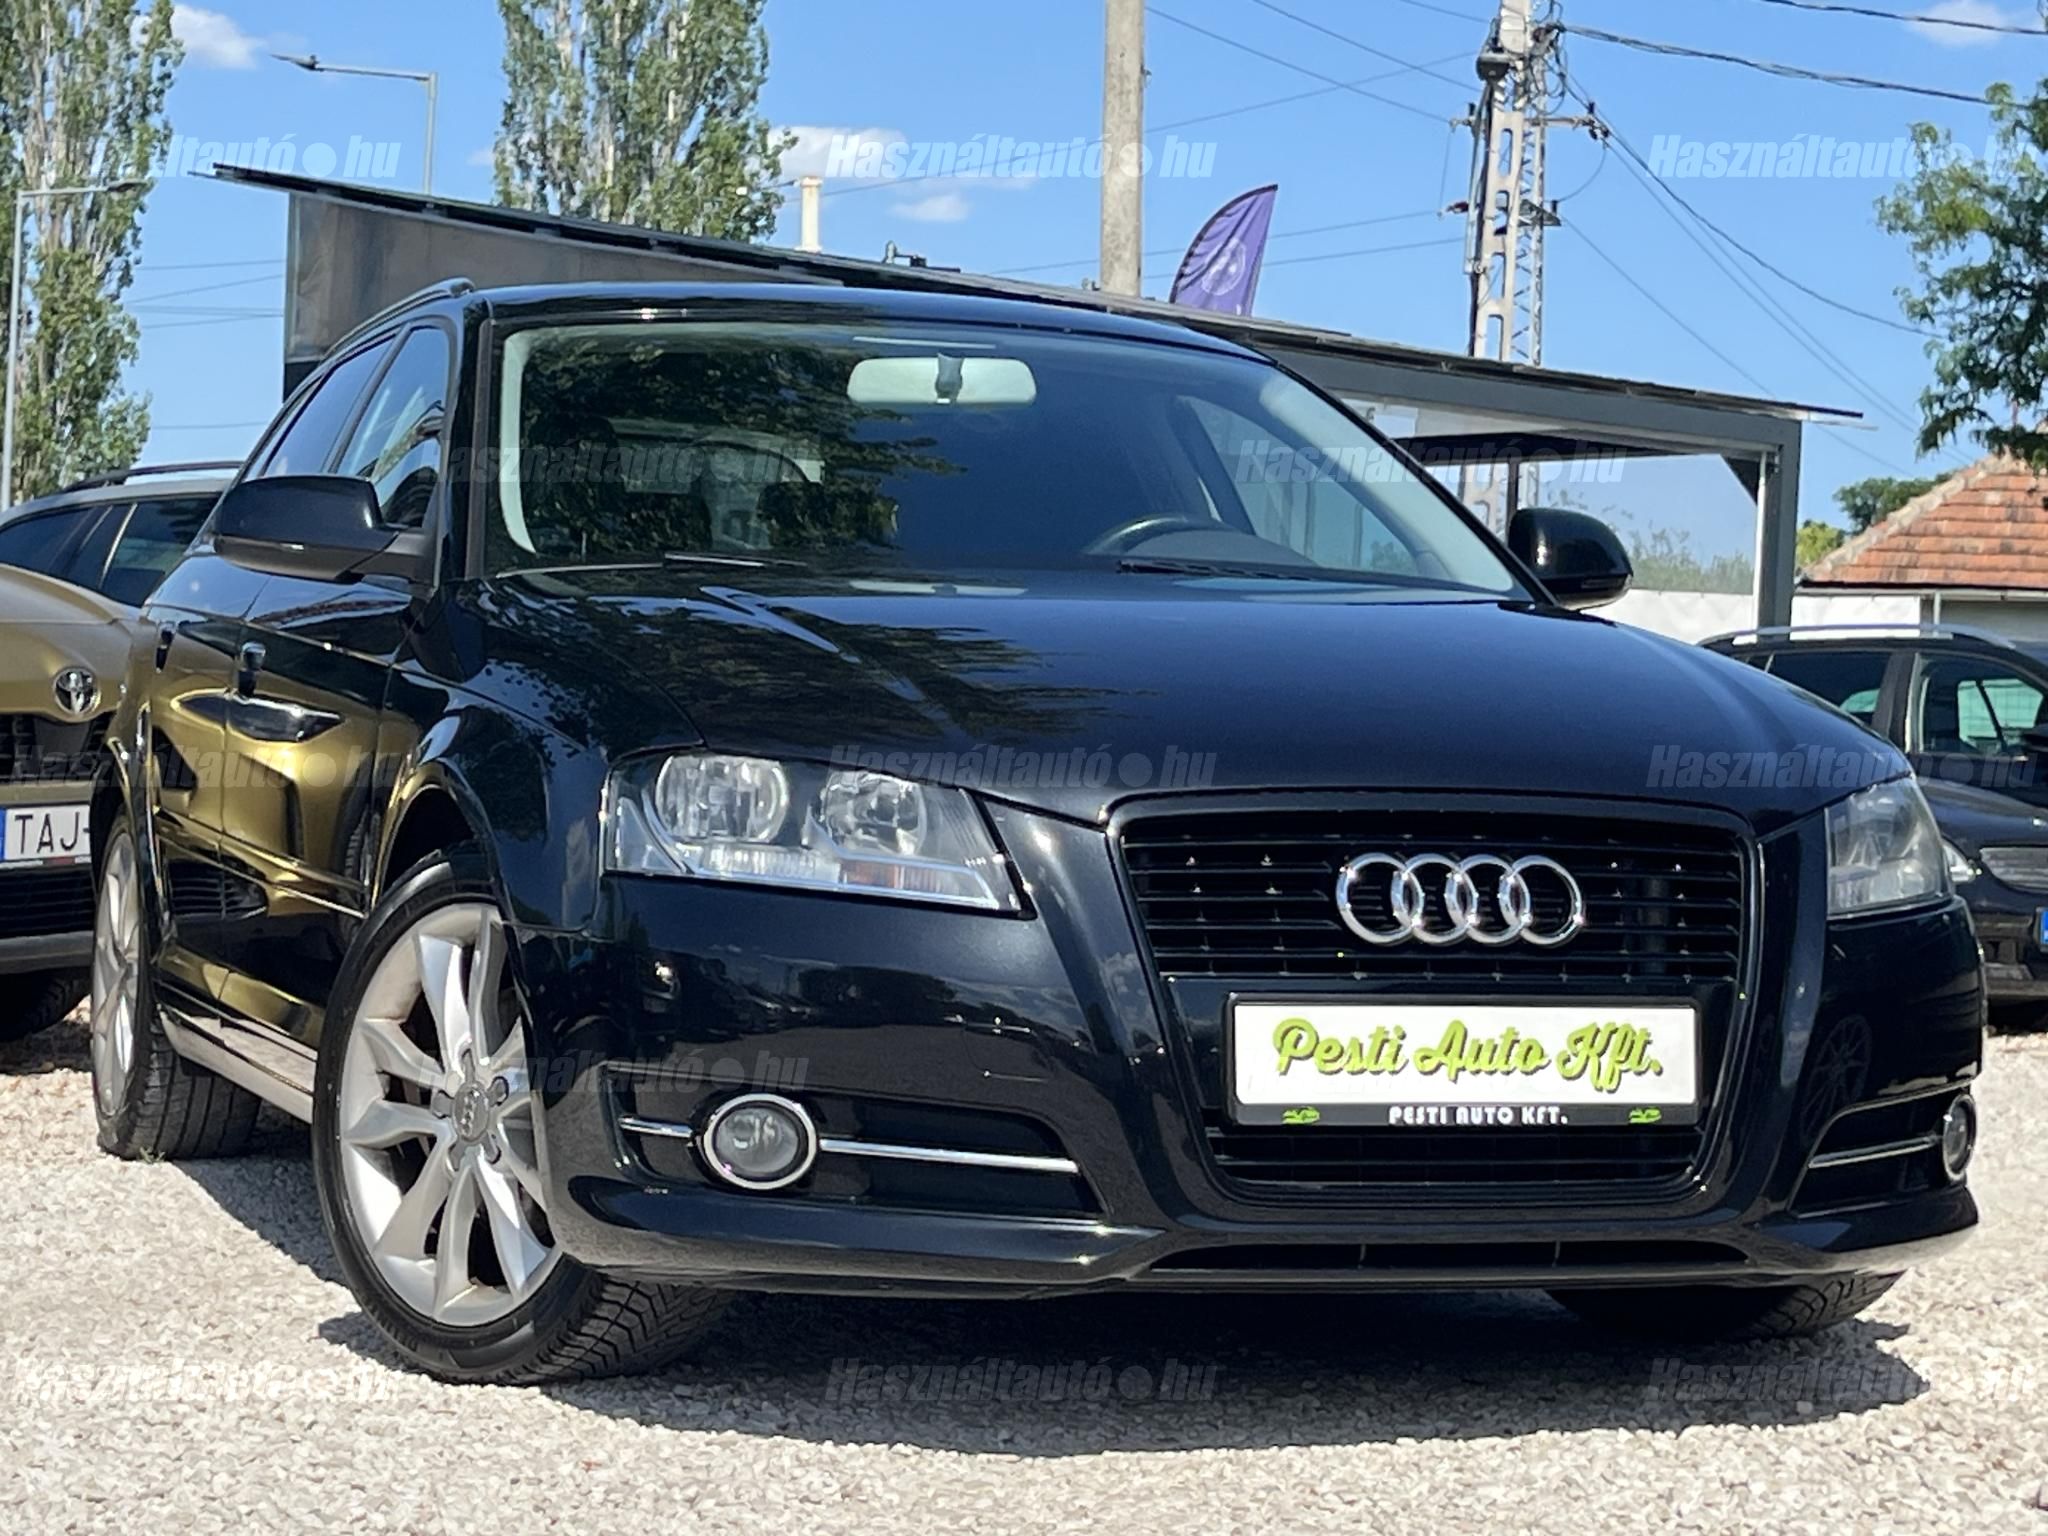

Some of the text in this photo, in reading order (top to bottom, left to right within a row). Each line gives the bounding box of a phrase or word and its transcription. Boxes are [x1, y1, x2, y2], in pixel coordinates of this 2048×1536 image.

[1273, 1018, 1406, 1077] Pesti
[1413, 1019, 1550, 1084] Auto
[1556, 1021, 1663, 1093] Kft.
[1388, 1106, 1568, 1125] PESTI AUTO KFT.
